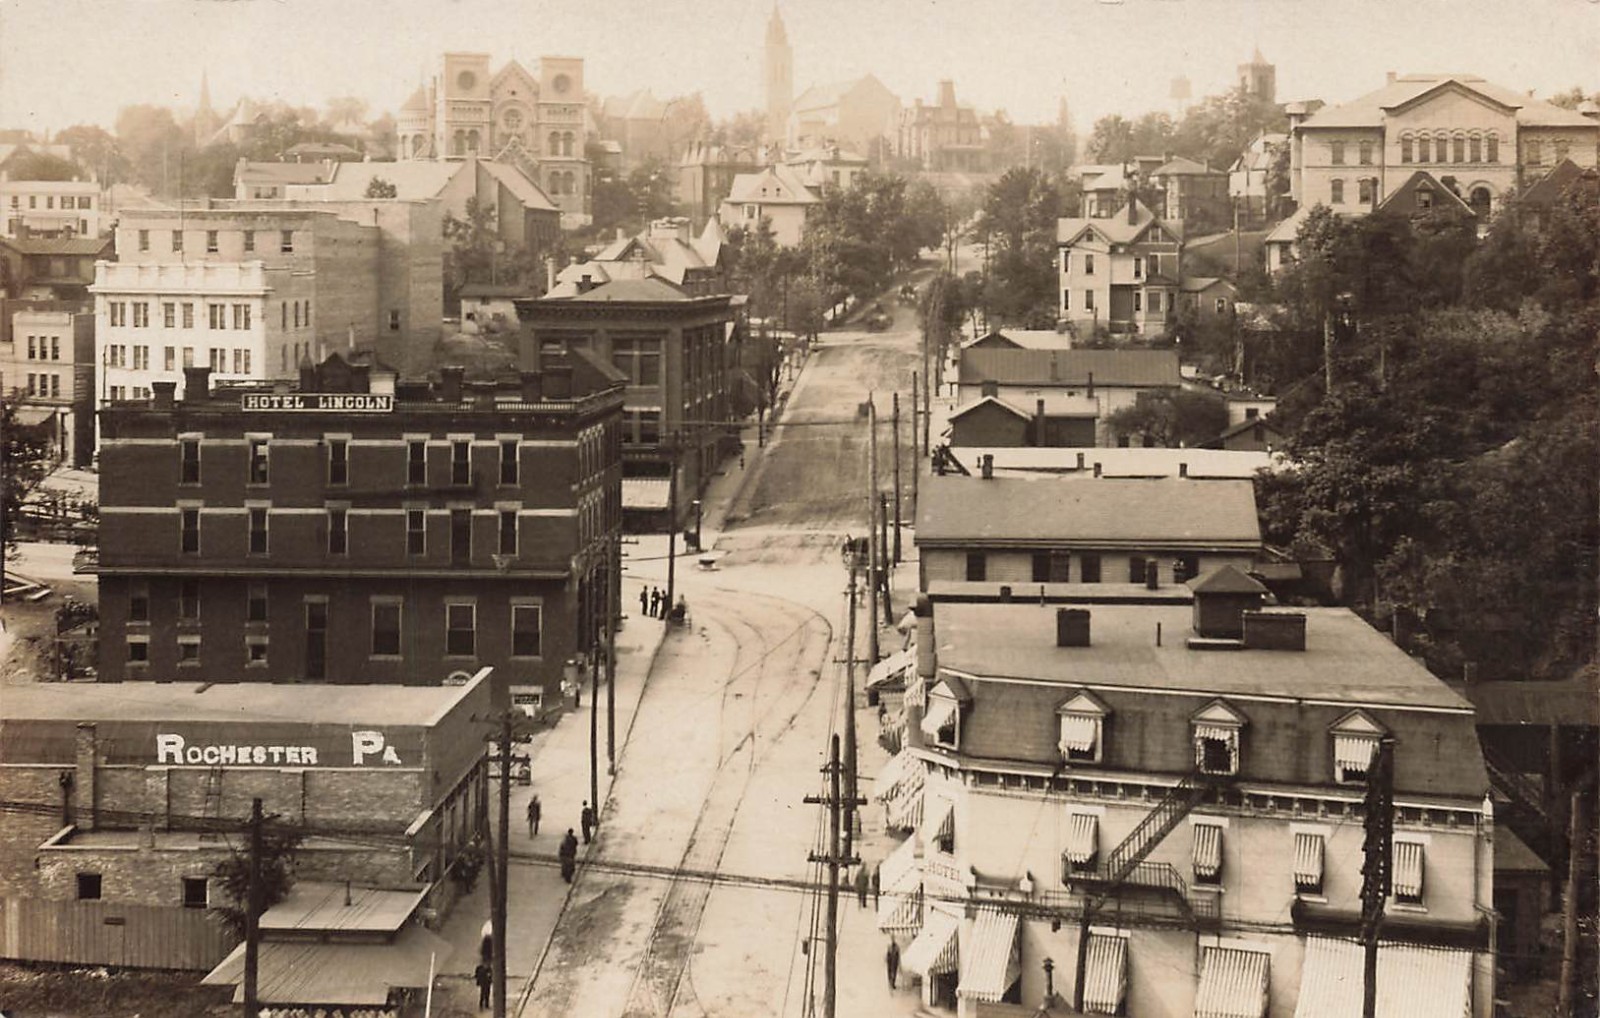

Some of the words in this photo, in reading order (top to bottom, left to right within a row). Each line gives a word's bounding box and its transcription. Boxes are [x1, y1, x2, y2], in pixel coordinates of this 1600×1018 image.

[248, 396, 304, 409] HOTEL
[318, 396, 388, 409] LINCOLN
[156, 733, 318, 764] ROCHESTER
[928, 860, 962, 883] HOTEL
